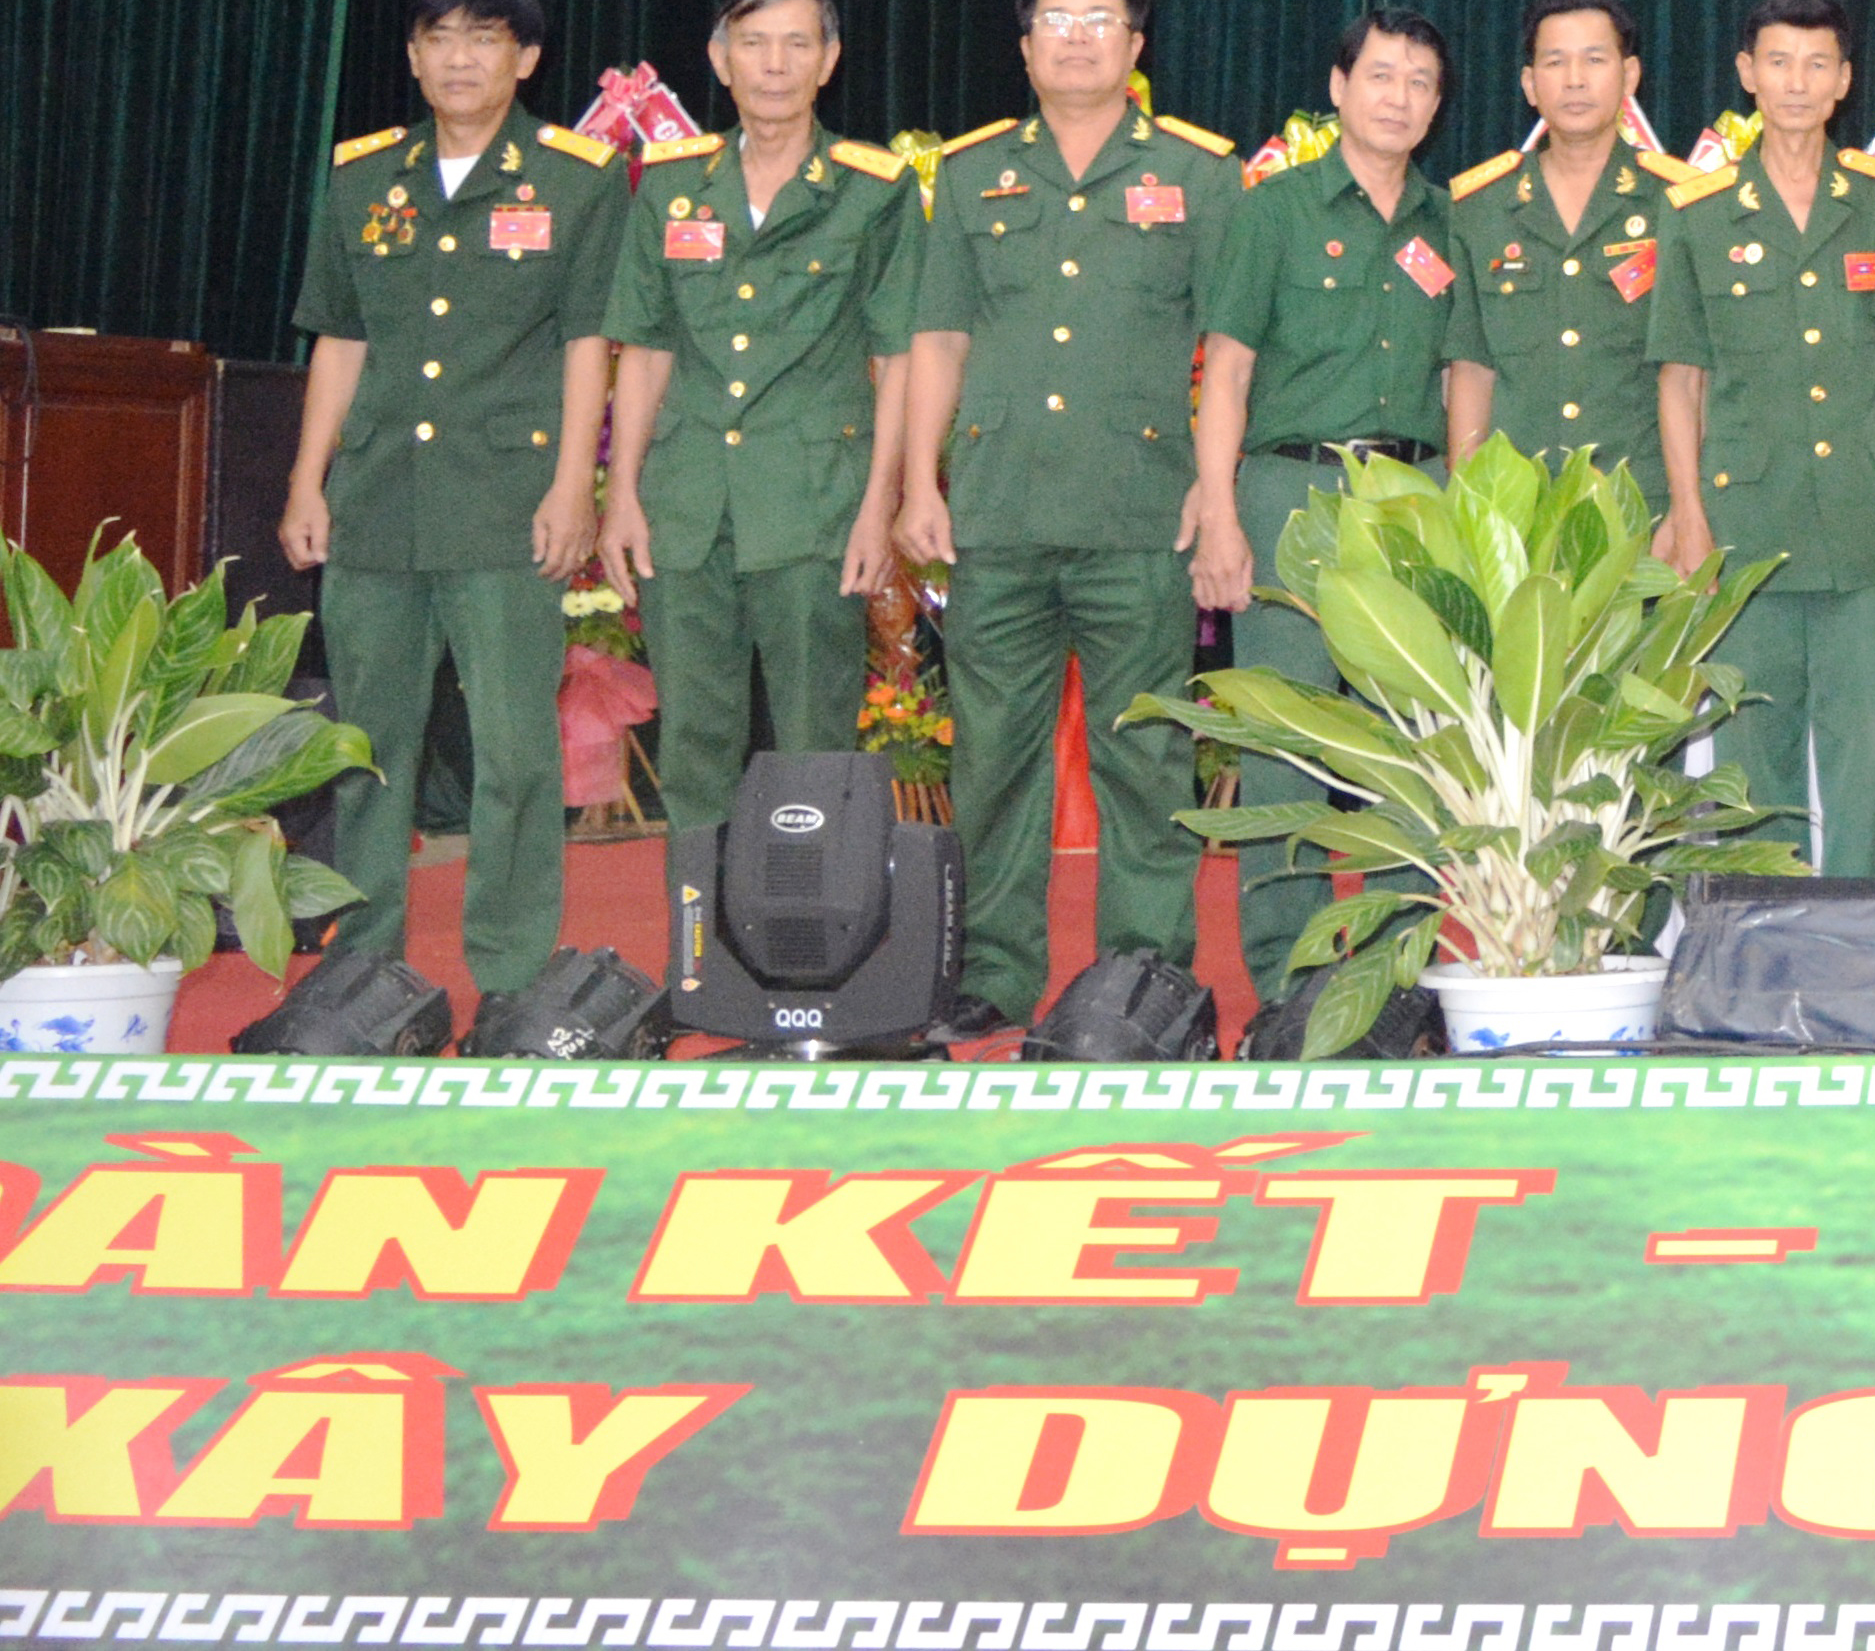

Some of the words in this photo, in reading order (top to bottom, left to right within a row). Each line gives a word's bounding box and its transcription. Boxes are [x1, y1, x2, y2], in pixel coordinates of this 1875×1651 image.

[775, 811, 821, 826] BEAM
[0, 1131, 606, 1301] ÀN
[626, 1130, 1557, 1306] KẾT
[0, 1352, 753, 1532] XÂY
